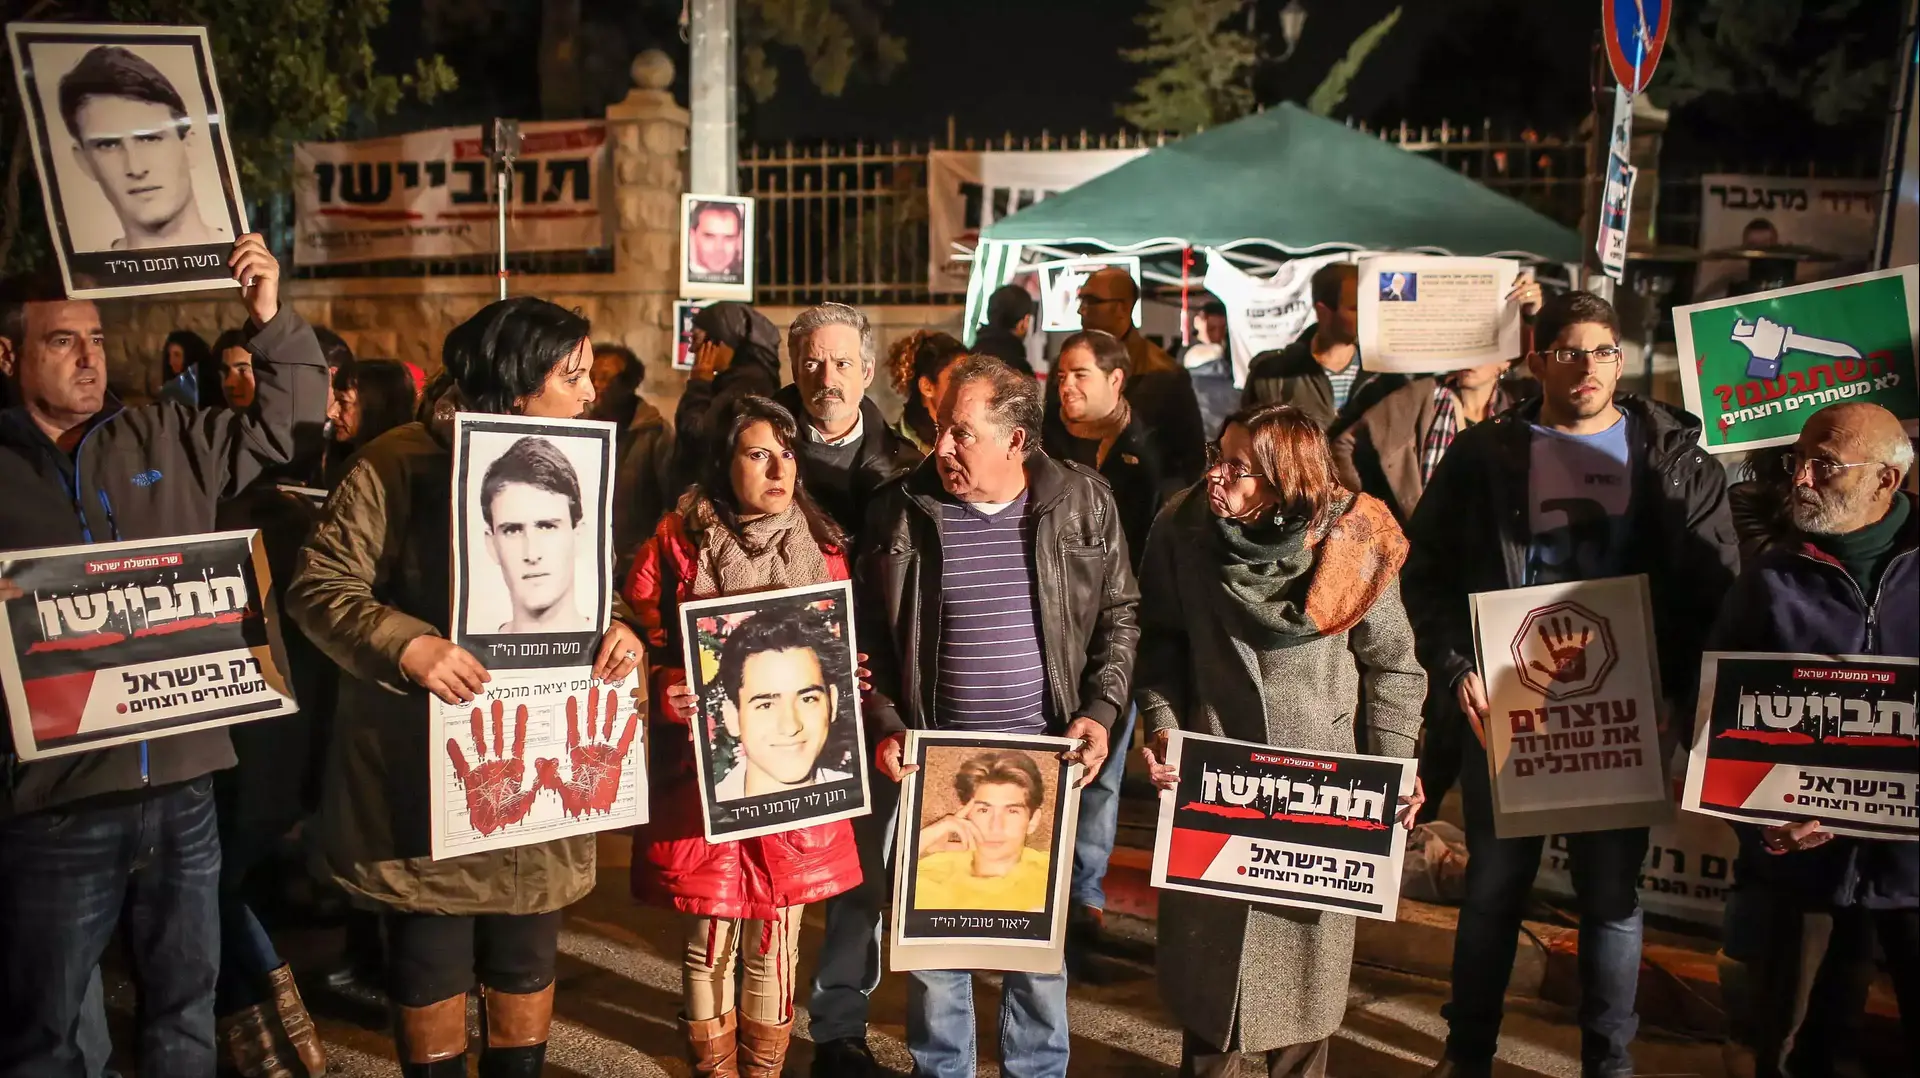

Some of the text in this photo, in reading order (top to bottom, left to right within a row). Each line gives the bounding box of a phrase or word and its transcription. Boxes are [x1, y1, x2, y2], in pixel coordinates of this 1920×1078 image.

[1710, 185, 1808, 212] מתגבר
[142, 257, 179, 272] תמם
[182, 254, 220, 269] משה
[1713, 350, 1895, 411] השתגענו?
[1721, 372, 1900, 426] לא משחררים רוצחים
[90, 555, 179, 572] שרי ממשלת ישראל
[520, 642, 549, 656] תמם
[553, 641, 580, 655] משה
[123, 656, 261, 694] רק בישראל
[1797, 669, 1890, 682] שרי ממשלת ישראל
[192, 680, 267, 703] משחררים
[486, 685, 530, 700] מהכלא
[533, 682, 567, 696] יציאה
[1508, 699, 1637, 734] עוצרים
[1511, 725, 1641, 753] את שחרור
[1254, 753, 1333, 770] שרי ממשלת ישראל
[1513, 748, 1643, 777] המחבלים
[1798, 771, 1906, 800] בישראל
[763, 797, 800, 814] קרמני
[804, 791, 821, 806] לוי
[824, 788, 847, 807] רונן
[1250, 843, 1375, 879] רק בישראל
[1302, 874, 1374, 894] משחררים
[960, 915, 994, 929] טובול
[997, 917, 1030, 930] ליאור
